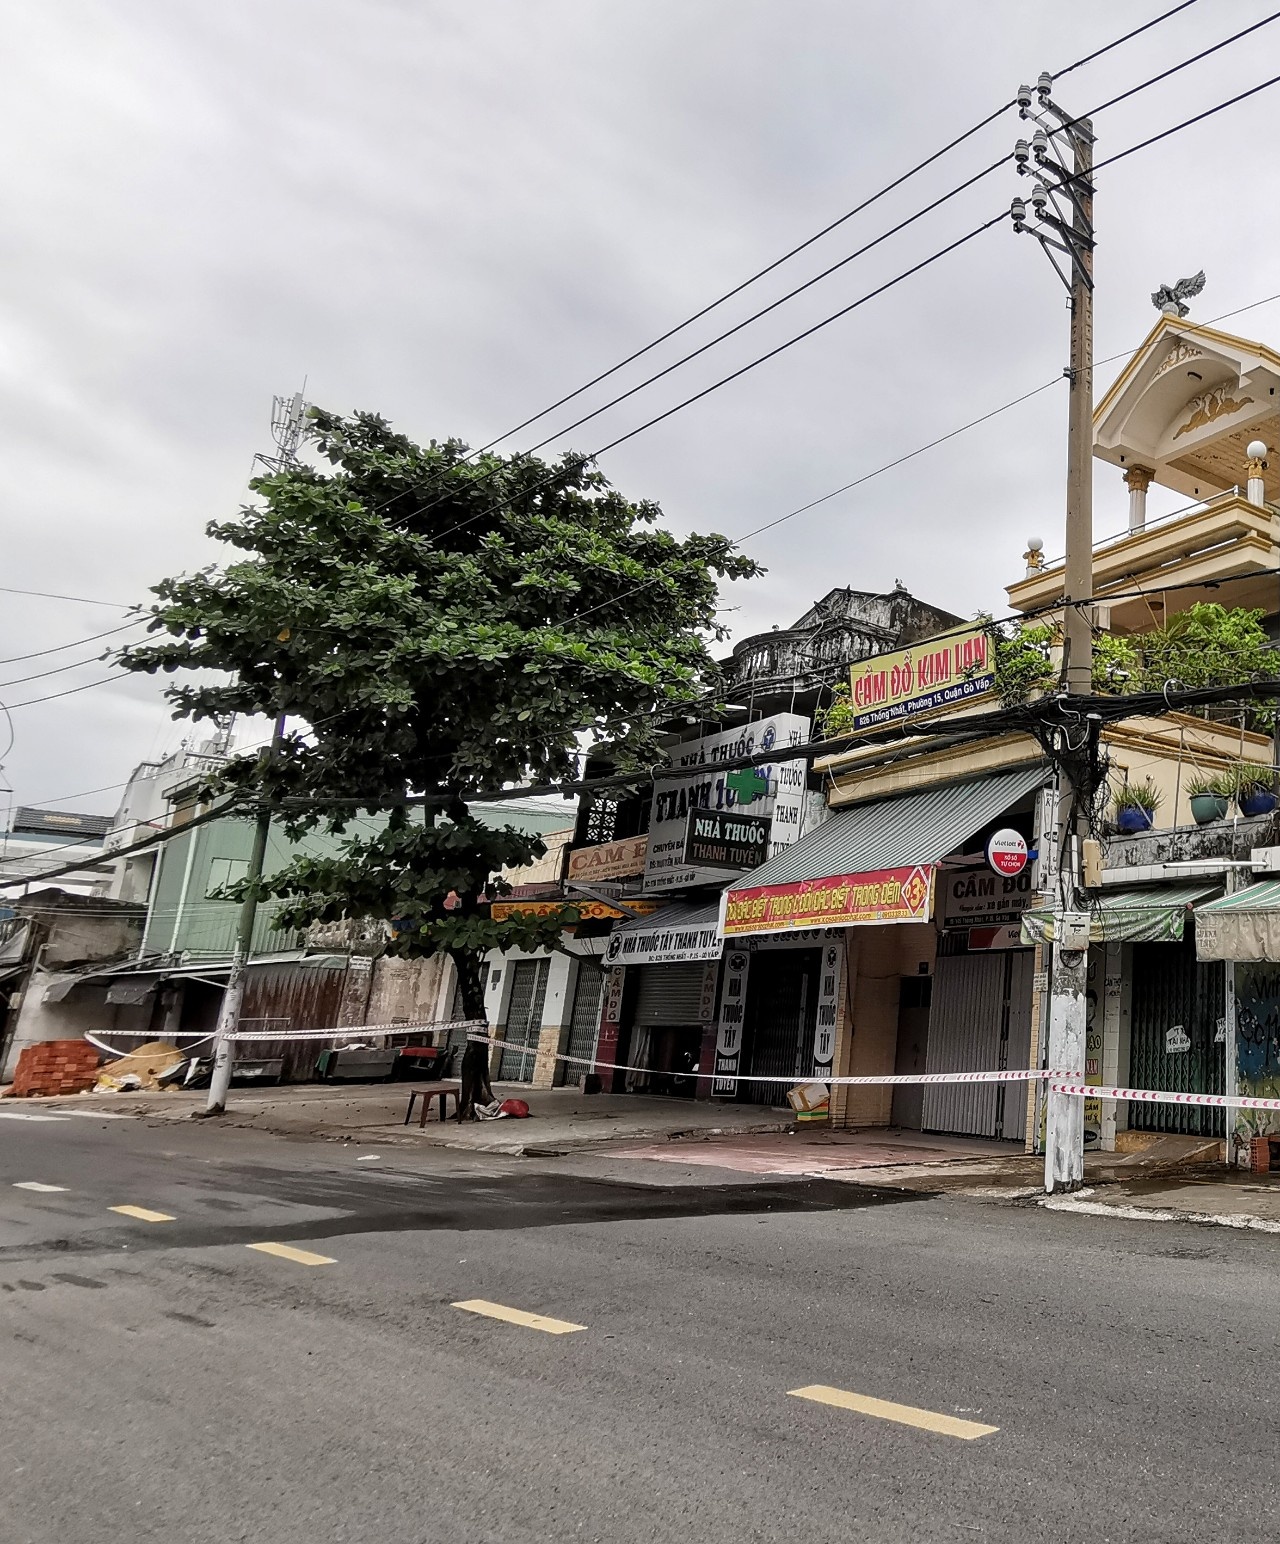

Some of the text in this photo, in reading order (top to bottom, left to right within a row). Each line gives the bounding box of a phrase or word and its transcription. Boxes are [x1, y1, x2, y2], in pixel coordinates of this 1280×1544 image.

[855, 664, 888, 710] CẦM
[891, 651, 915, 699] ĐỒ
[917, 649, 951, 690] KIM
[963, 684, 974, 693] Gò
[975, 677, 990, 690] Vấp
[694, 815, 765, 844] NHÀ THUỐC
[693, 843, 727, 861] THANH
[953, 873, 995, 899] CẦM
[660, 930, 675, 951] TÂY
[674, 931, 699, 950] THANH
